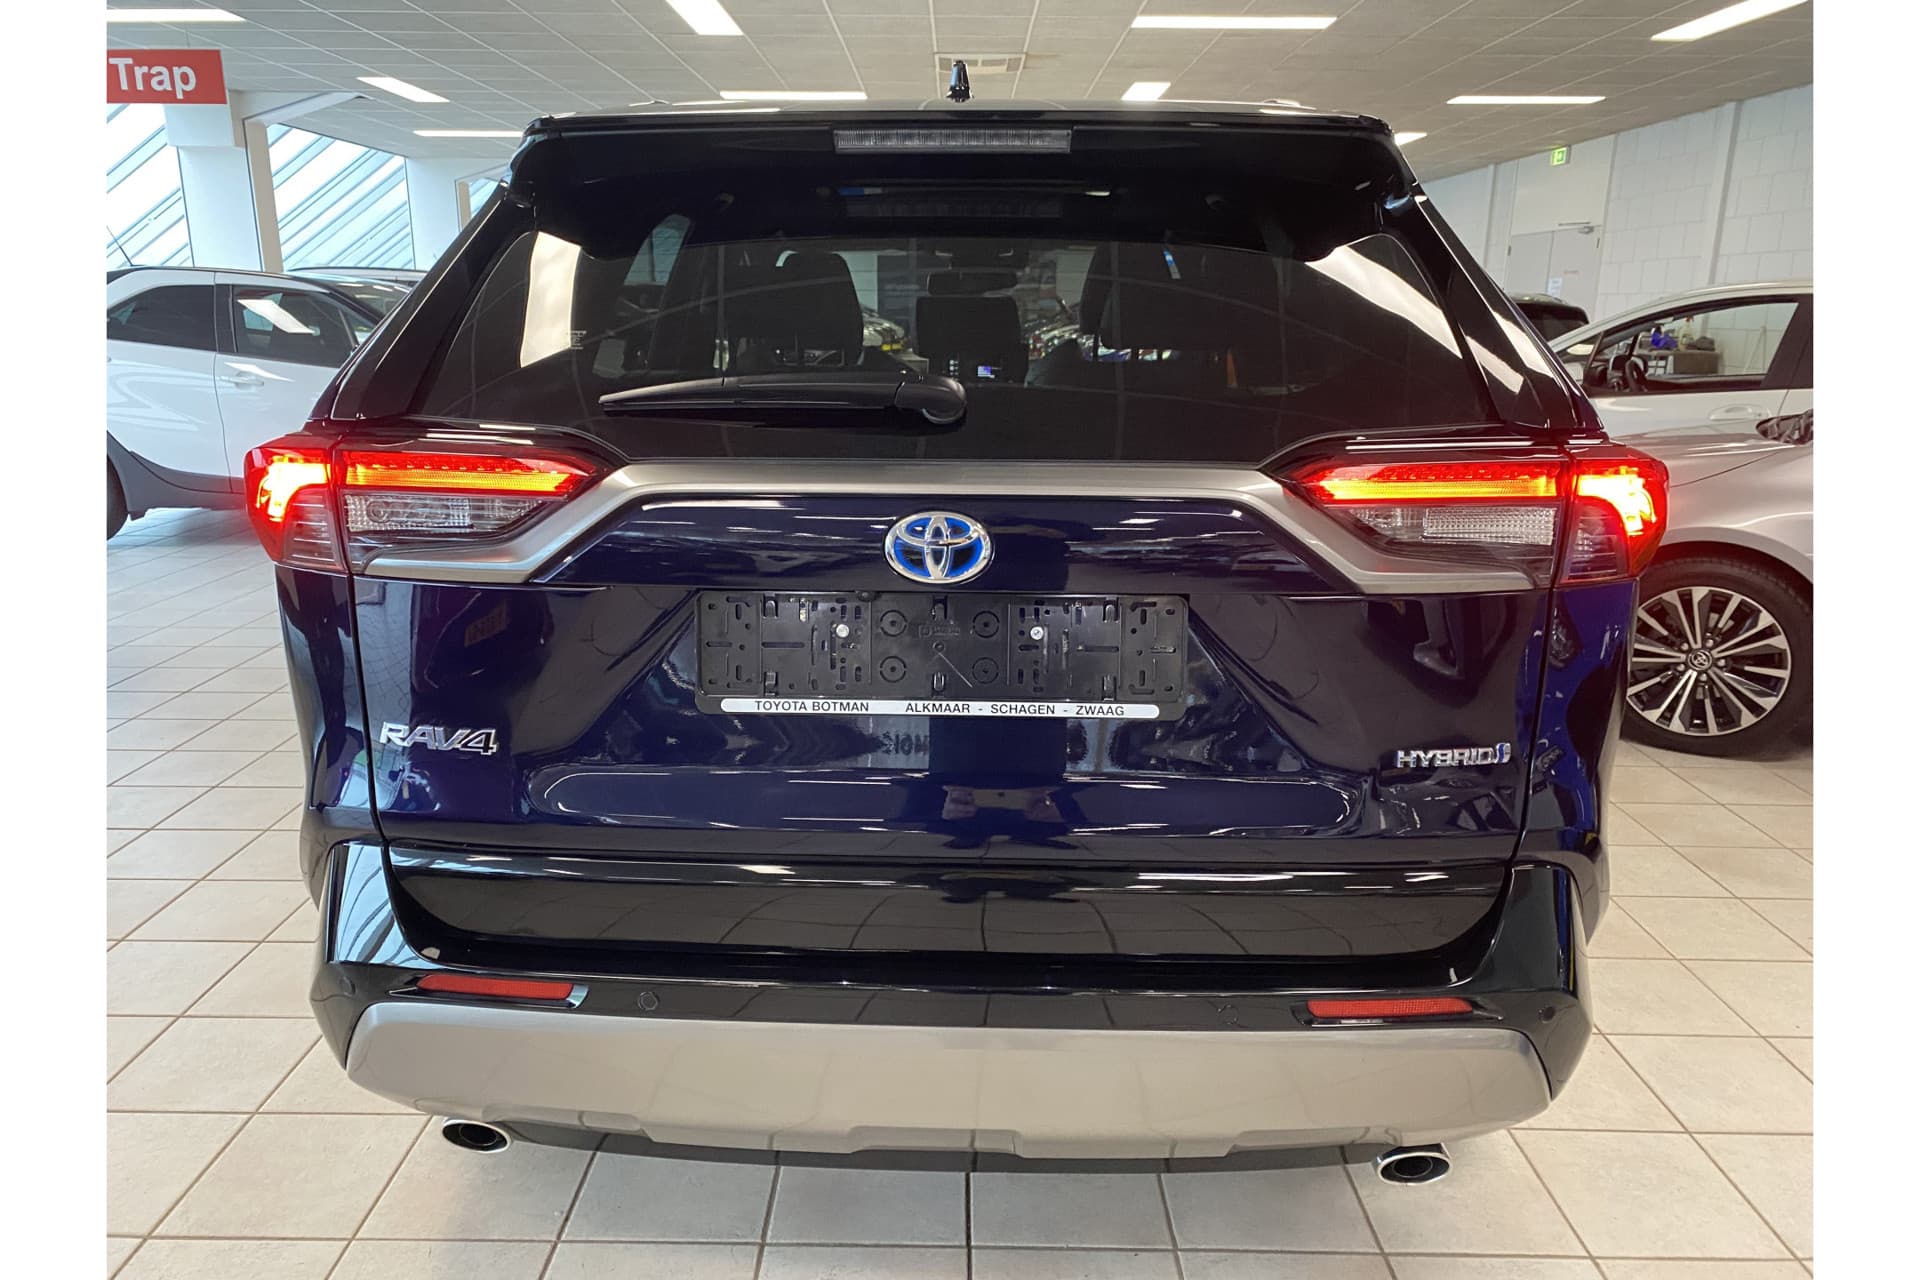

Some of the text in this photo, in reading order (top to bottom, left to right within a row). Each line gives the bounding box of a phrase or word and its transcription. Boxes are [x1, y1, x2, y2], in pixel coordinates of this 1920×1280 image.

[109, 57, 197, 99] Trap
[755, 700, 807, 712] TOYOTA
[812, 701, 869, 713] BOTMAN
[905, 702, 971, 714] ALKMAAR
[990, 703, 1056, 716] SCHAGEN
[1075, 705, 1125, 716] ZWAAG
[379, 722, 497, 755] RAV4
[1396, 747, 1495, 768] HYBRID
